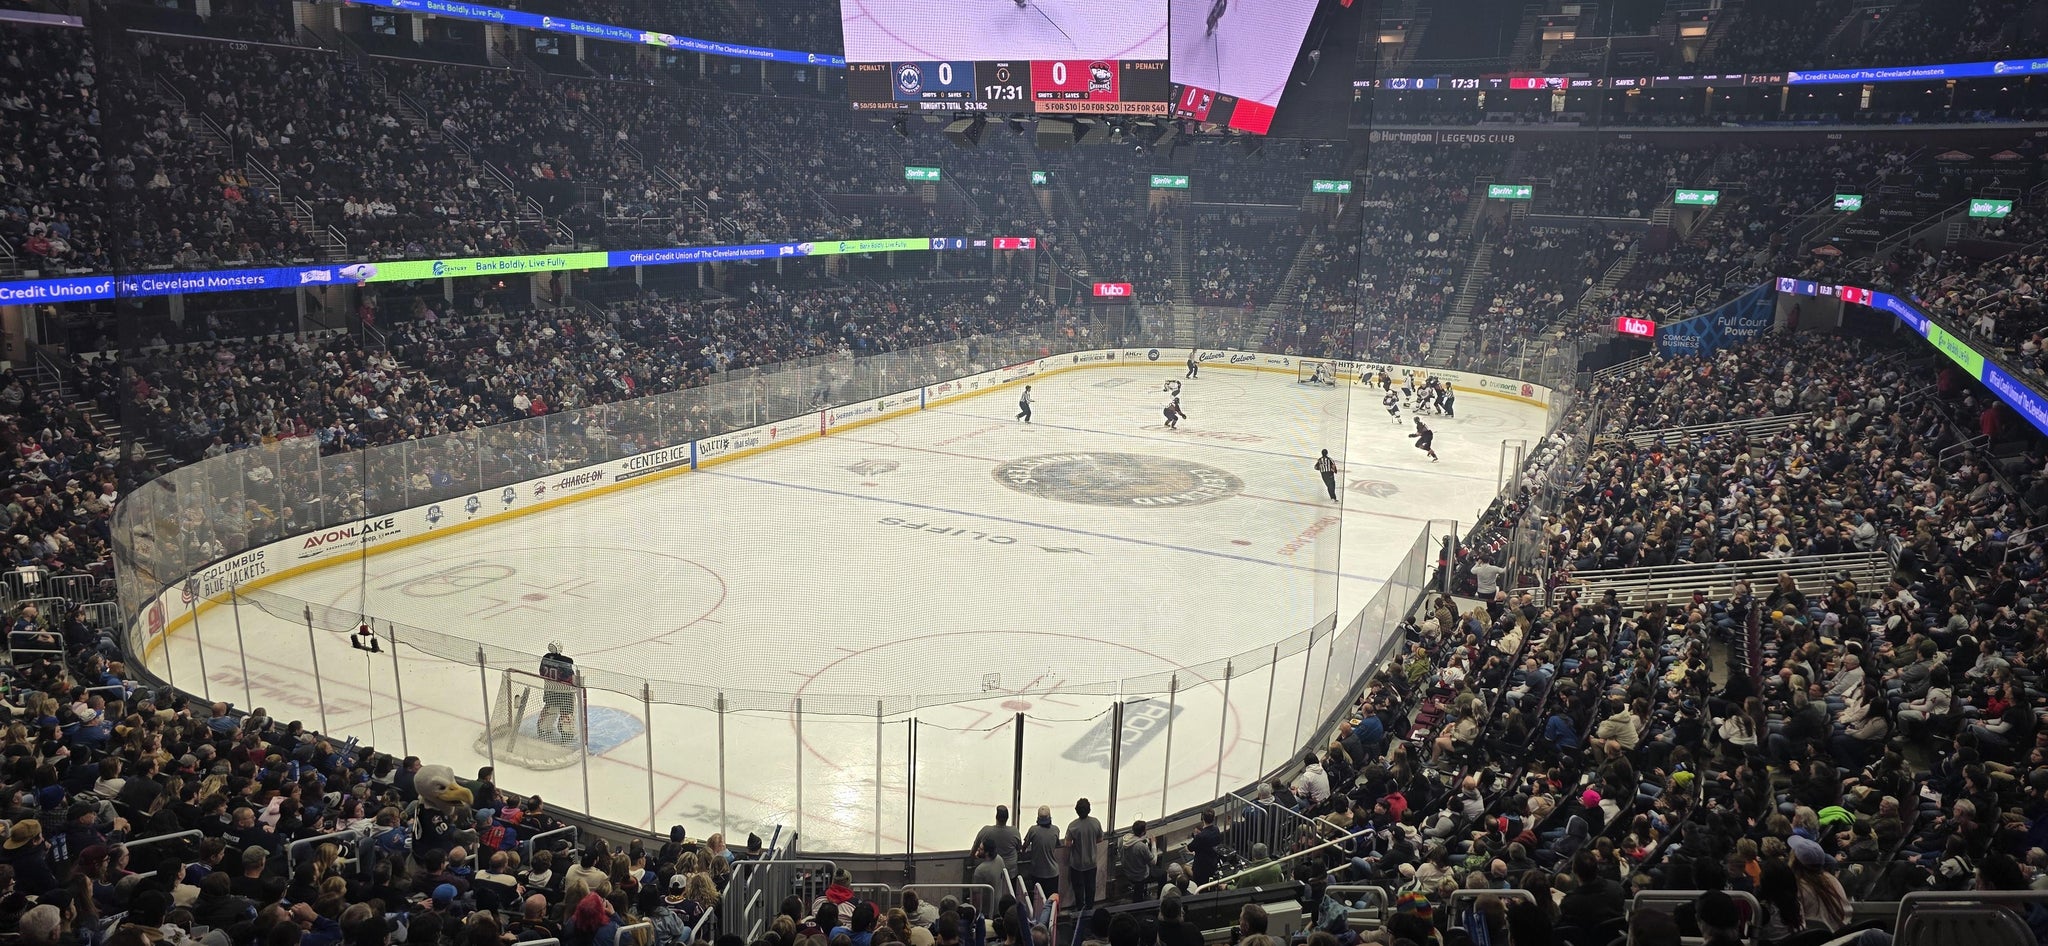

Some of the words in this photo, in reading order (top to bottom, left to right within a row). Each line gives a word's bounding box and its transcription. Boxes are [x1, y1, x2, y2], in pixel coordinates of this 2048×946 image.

[427, 1, 446, 11] Bank
[446, 5, 471, 15] Boldly.
[472, 7, 487, 17] Live
[487, 9, 505, 20] Fully.
[571, 22, 584, 32] Bank
[606, 28, 618, 36] Live
[680, 39, 694, 47] Credit
[724, 46, 749, 55] Cleveland
[749, 49, 774, 58] Monsters
[938, 62, 953, 85] 0
[1052, 61, 1067, 85] 0
[1804, 73, 1827, 81] Credit
[1828, 72, 1849, 80] Union
[1850, 71, 1860, 79] of
[1861, 70, 1875, 79] The
[1876, 69, 1911, 78] Cleveland
[1911, 68, 1945, 76] Monsters
[1374, 79, 1380, 87] 2
[1416, 78, 1424, 88] 0
[1451, 78, 1480, 88] 17:31
[1528, 78, 1536, 88] 0
[1597, 79, 1603, 87] 2
[1639, 77, 1647, 86] 0
[1751, 75, 1767, 83] 7:11
[1769, 75, 1780, 83] PM
[985, 85, 1023, 100] 17:31
[1186, 88, 1196, 106] 0
[965, 102, 988, 110] $3,162
[1065, 103, 1078, 111] $10
[1106, 103, 1119, 111] $20
[1124, 104, 1136, 112] 125
[1137, 104, 1151, 112] FOR
[1152, 104, 1165, 112] $40
[1381, 130, 1432, 143] Huntington
[1441, 133, 1487, 143] LEGENDS
[1488, 134, 1515, 143] CLUB
[907, 168, 925, 179] Sprite
[1152, 176, 1172, 187] Sprite
[1314, 182, 1334, 192] Sprite
[1490, 186, 1513, 196] Sprite
[1676, 191, 1699, 203] Sprite
[1971, 203, 1993, 213] Sprite
[956, 239, 962, 248] 0
[999, 239, 1006, 248] 2
[630, 253, 654, 262] Official
[655, 252, 674, 261] Credit
[675, 251, 693, 260] Union
[694, 251, 700, 259] of
[701, 250, 712, 258] The
[712, 248, 739, 257] Cleveland
[740, 247, 765, 256] Monsters
[476, 261, 497, 271] Bank
[499, 260, 527, 271] Boldly.
[529, 259, 546, 268] Live
[547, 257, 566, 268] Fully.
[0, 285, 46, 300] Credit
[50, 283, 92, 296] Union
[95, 281, 110, 294] of
[113, 280, 139, 293] The
[142, 276, 205, 291] Cleveland
[207, 274, 265, 288] Monsters
[1100, 285, 1124, 296] fubo
[1807, 284, 1813, 293] 0
[1846, 289, 1853, 298] 0
[1625, 319, 1647, 335] fubo
[1717, 316, 1737, 326] Full
[1737, 317, 1767, 327] Court
[1724, 326, 1758, 336] Power
[1663, 334, 1700, 342] COMCAST
[1662, 340, 1700, 349] BUSINESS
[1338, 361, 1354, 370] HITS
[1489, 379, 1518, 392] truenorth
[629, 450, 668, 470] CENTER
[670, 446, 685, 462] ICE
[303, 517, 395, 550] AVONLAKE
[877, 515, 1018, 546] CLIFFS
[202, 550, 265, 582] COLUMBUS
[204, 575, 226, 597] BLUE
[228, 560, 267, 588] JACKETS
[435, 822, 448, 835] 00
